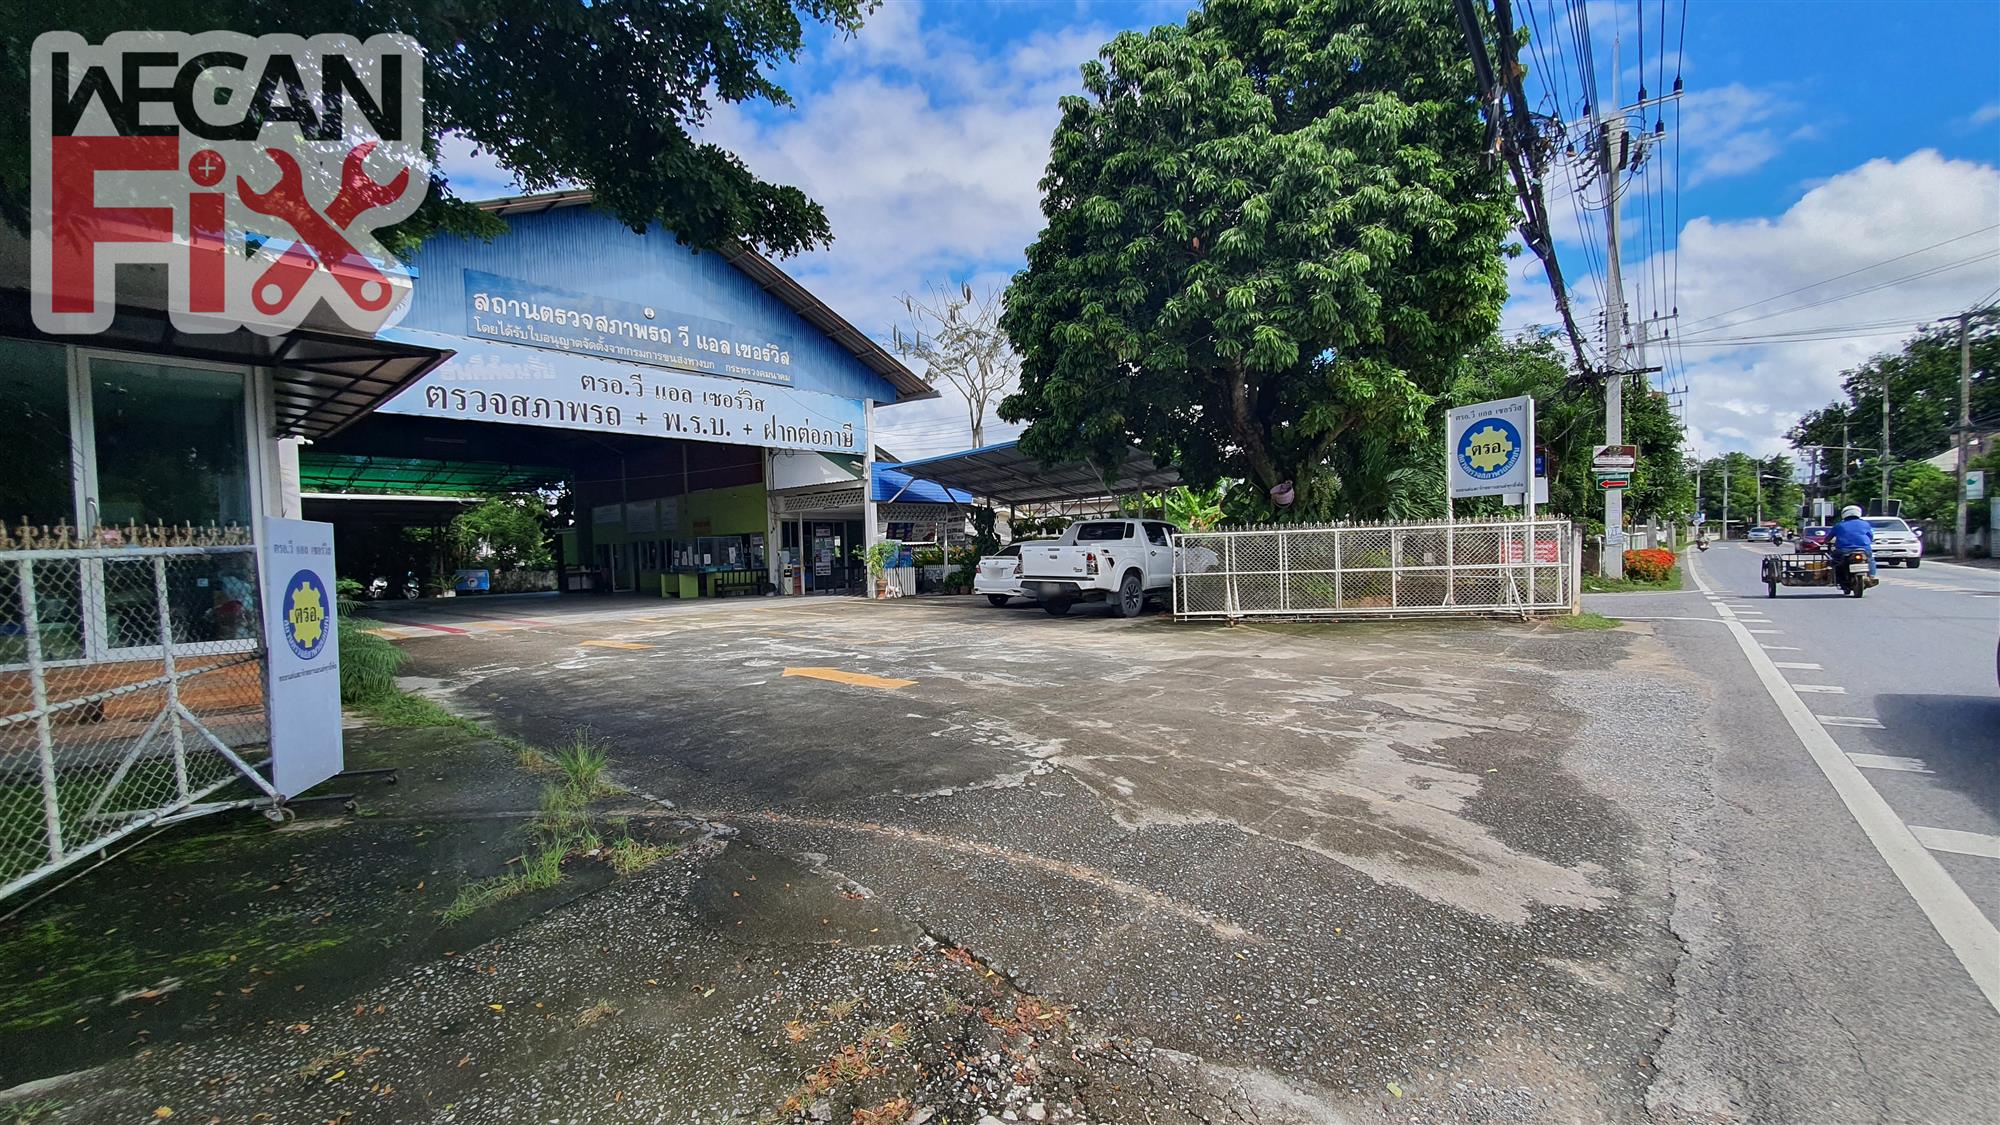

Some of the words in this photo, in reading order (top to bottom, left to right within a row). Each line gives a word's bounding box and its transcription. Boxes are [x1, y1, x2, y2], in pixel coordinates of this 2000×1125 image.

[678, 326, 689, 347] วี
[697, 334, 731, 355] แอล
[735, 343, 790, 366] เซอร์วิส
[725, 363, 791, 382] กระทรวงคมนาคม
[581, 373, 643, 398] ตรอ.วี
[655, 385, 693, 404] แอล
[703, 388, 765, 413] เซอร์วิส
[425, 384, 622, 427] ตรวจสภาพรถ
[663, 412, 731, 437] พ.ร.บ.
[764, 415, 853, 448] ฝากต่อภาษี
[1471, 442, 1506, 456] ตรอ.
[294, 606, 320, 624] ตรอ.
